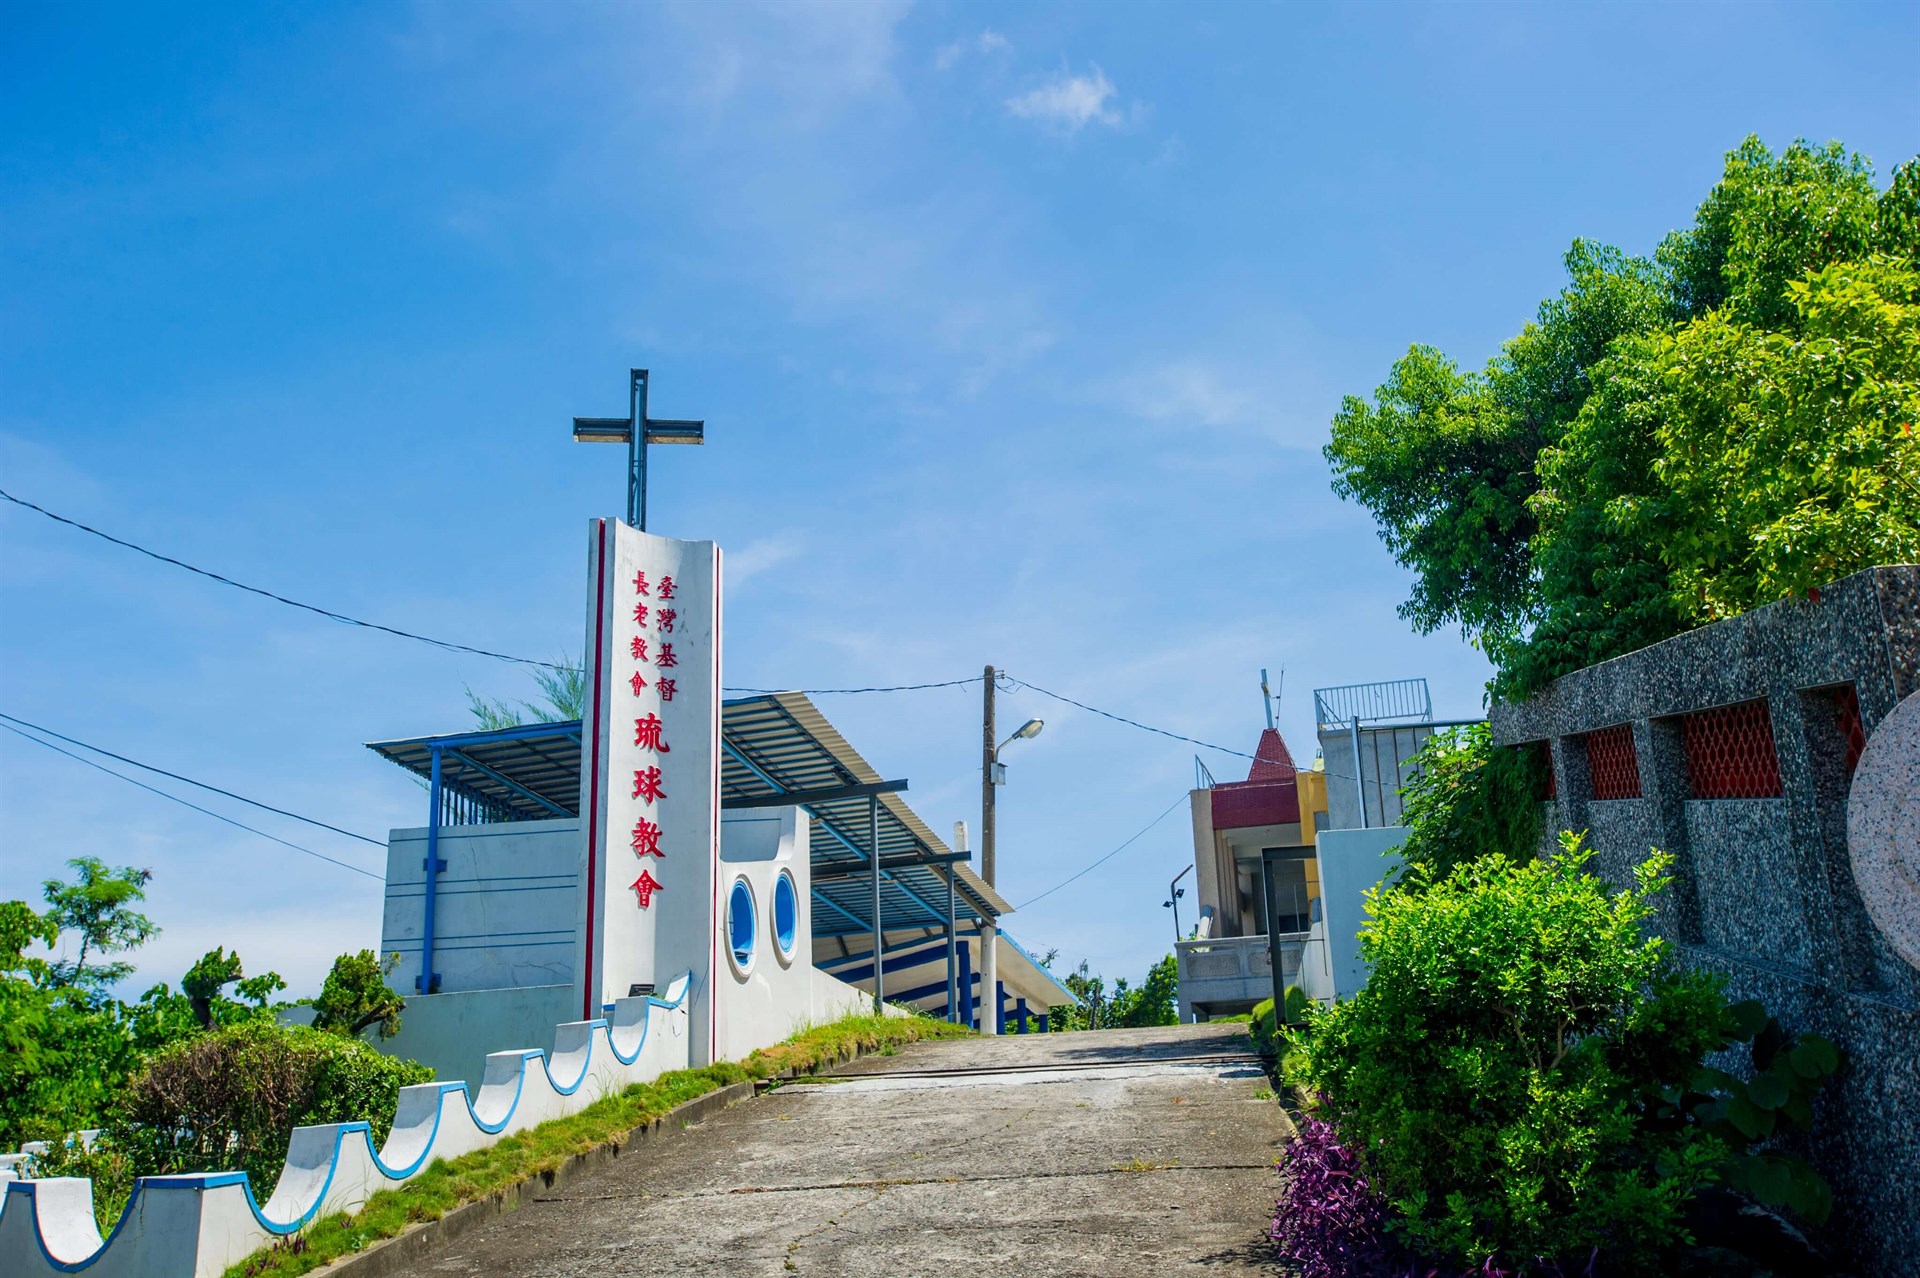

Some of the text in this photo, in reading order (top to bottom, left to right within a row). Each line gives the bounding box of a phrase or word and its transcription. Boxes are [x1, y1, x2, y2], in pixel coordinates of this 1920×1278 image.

[629, 569, 650, 697] 長老教會
[655, 576, 678, 702] 臺灣基督
[630, 712, 670, 909] 琉球教會
